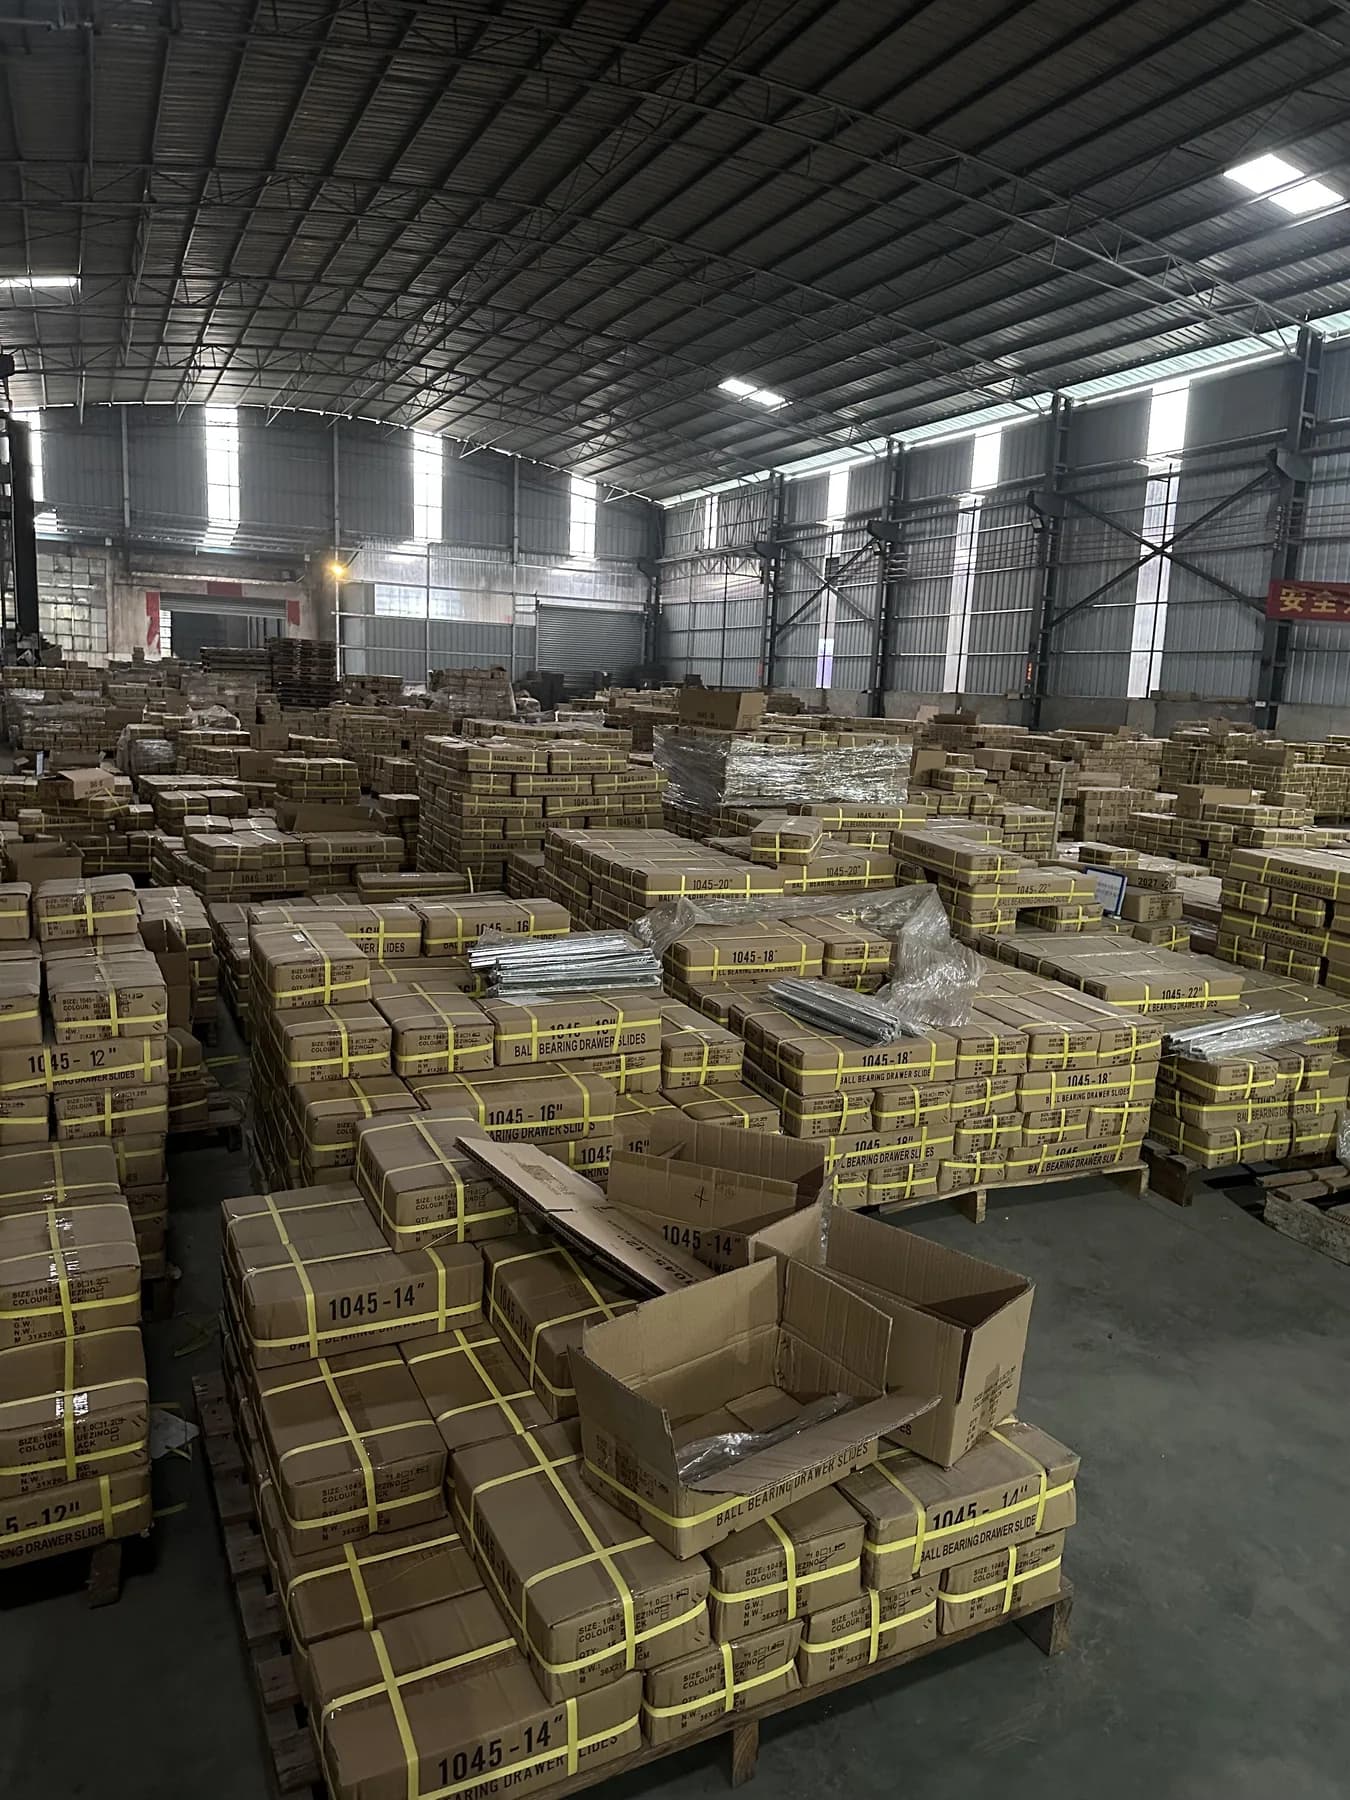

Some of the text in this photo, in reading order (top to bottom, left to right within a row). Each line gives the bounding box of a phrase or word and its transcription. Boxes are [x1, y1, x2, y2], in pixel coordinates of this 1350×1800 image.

[693, 878, 733, 890] 1045-20"
[514, 1042, 532, 1057] BAL
[539, 1038, 578, 1055] BEARING
[579, 1035, 615, 1051] DRAWER
[857, 1071, 885, 1083] BEARING
[886, 1069, 913, 1081] DRAWER
[1061, 1092, 1086, 1102] BEARING
[1087, 1089, 1110, 1100] DRAWER
[520, 1121, 563, 1139] DRAWER
[563, 1118, 595, 1134] SLIDS
[847, 1154, 878, 1169] BEARING
[879, 1151, 910, 1165] DRAWER
[1046, 1159, 1075, 1171] BEARING
[1075, 1155, 1101, 1168] DRAWER
[329, 1282, 425, 1321] 1045-14"
[716, 1442, 869, 1527] BALL BEARING DRAWER SLIDES
[25, 1532, 73, 1555] DRAWER
[942, 1535, 979, 1559] BEARING
[980, 1525, 1015, 1545] DRAWER
[578, 1622, 601, 1635] SIZE:
[578, 1624, 618, 1644] COLOUR:
[438, 1713, 564, 1786] 1045-14"
[503, 1756, 566, 1789] DRAWER
